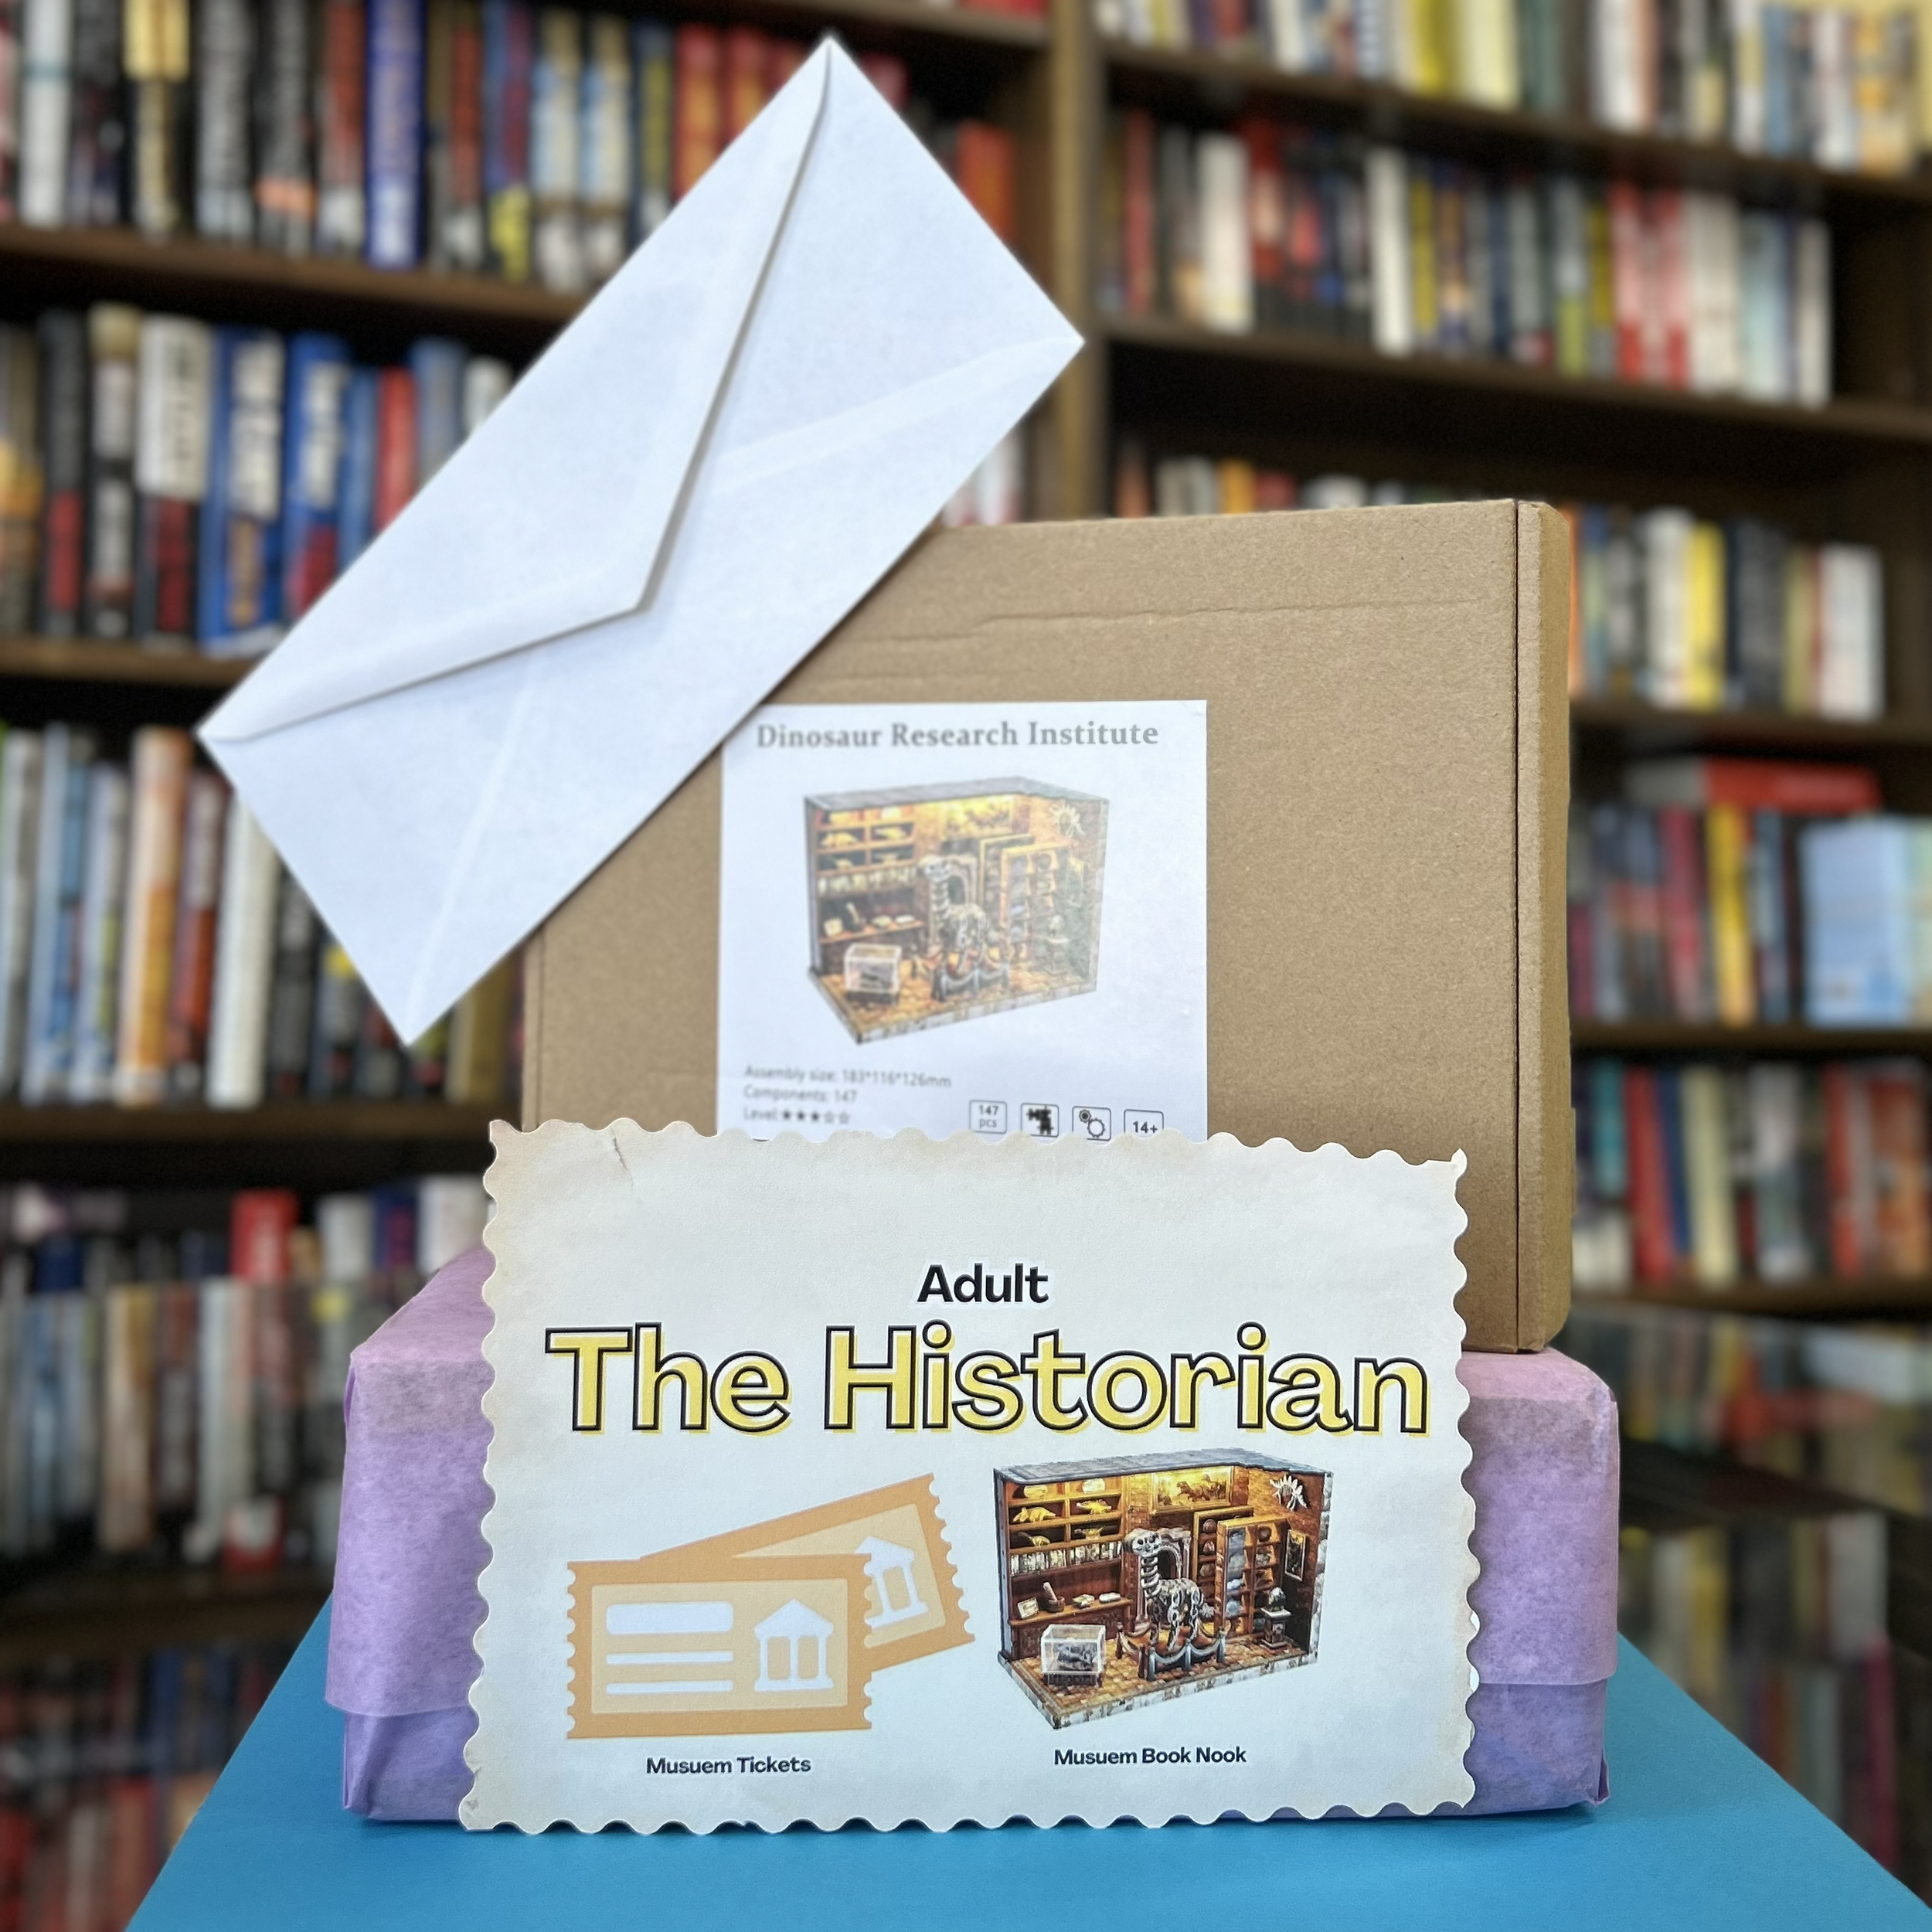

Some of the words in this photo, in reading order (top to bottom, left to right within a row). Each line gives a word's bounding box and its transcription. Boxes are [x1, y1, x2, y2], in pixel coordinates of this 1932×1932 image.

[757, 723, 882, 748] Dinosaur
[891, 722, 1018, 747] Research
[1028, 720, 1159, 746] Institute
[744, 1066, 805, 1083] Assembly
[810, 1067, 837, 1082] size:
[743, 1084, 828, 1102] Components:
[835, 1090, 858, 1103] 147
[978, 1105, 999, 1116] 147
[979, 1117, 997, 1129] pcs
[1132, 1121, 1158, 1134] 14+
[917, 1262, 1049, 1303] Adult
[545, 1321, 792, 1435] The
[824, 1318, 1430, 1437] Historian
[646, 1757, 733, 1774] Musuem
[736, 1755, 811, 1774] Tickets
[1054, 1748, 1138, 1765] Musuem
[1141, 1747, 1192, 1764] Book
[1196, 1746, 1247, 1764] Nook
